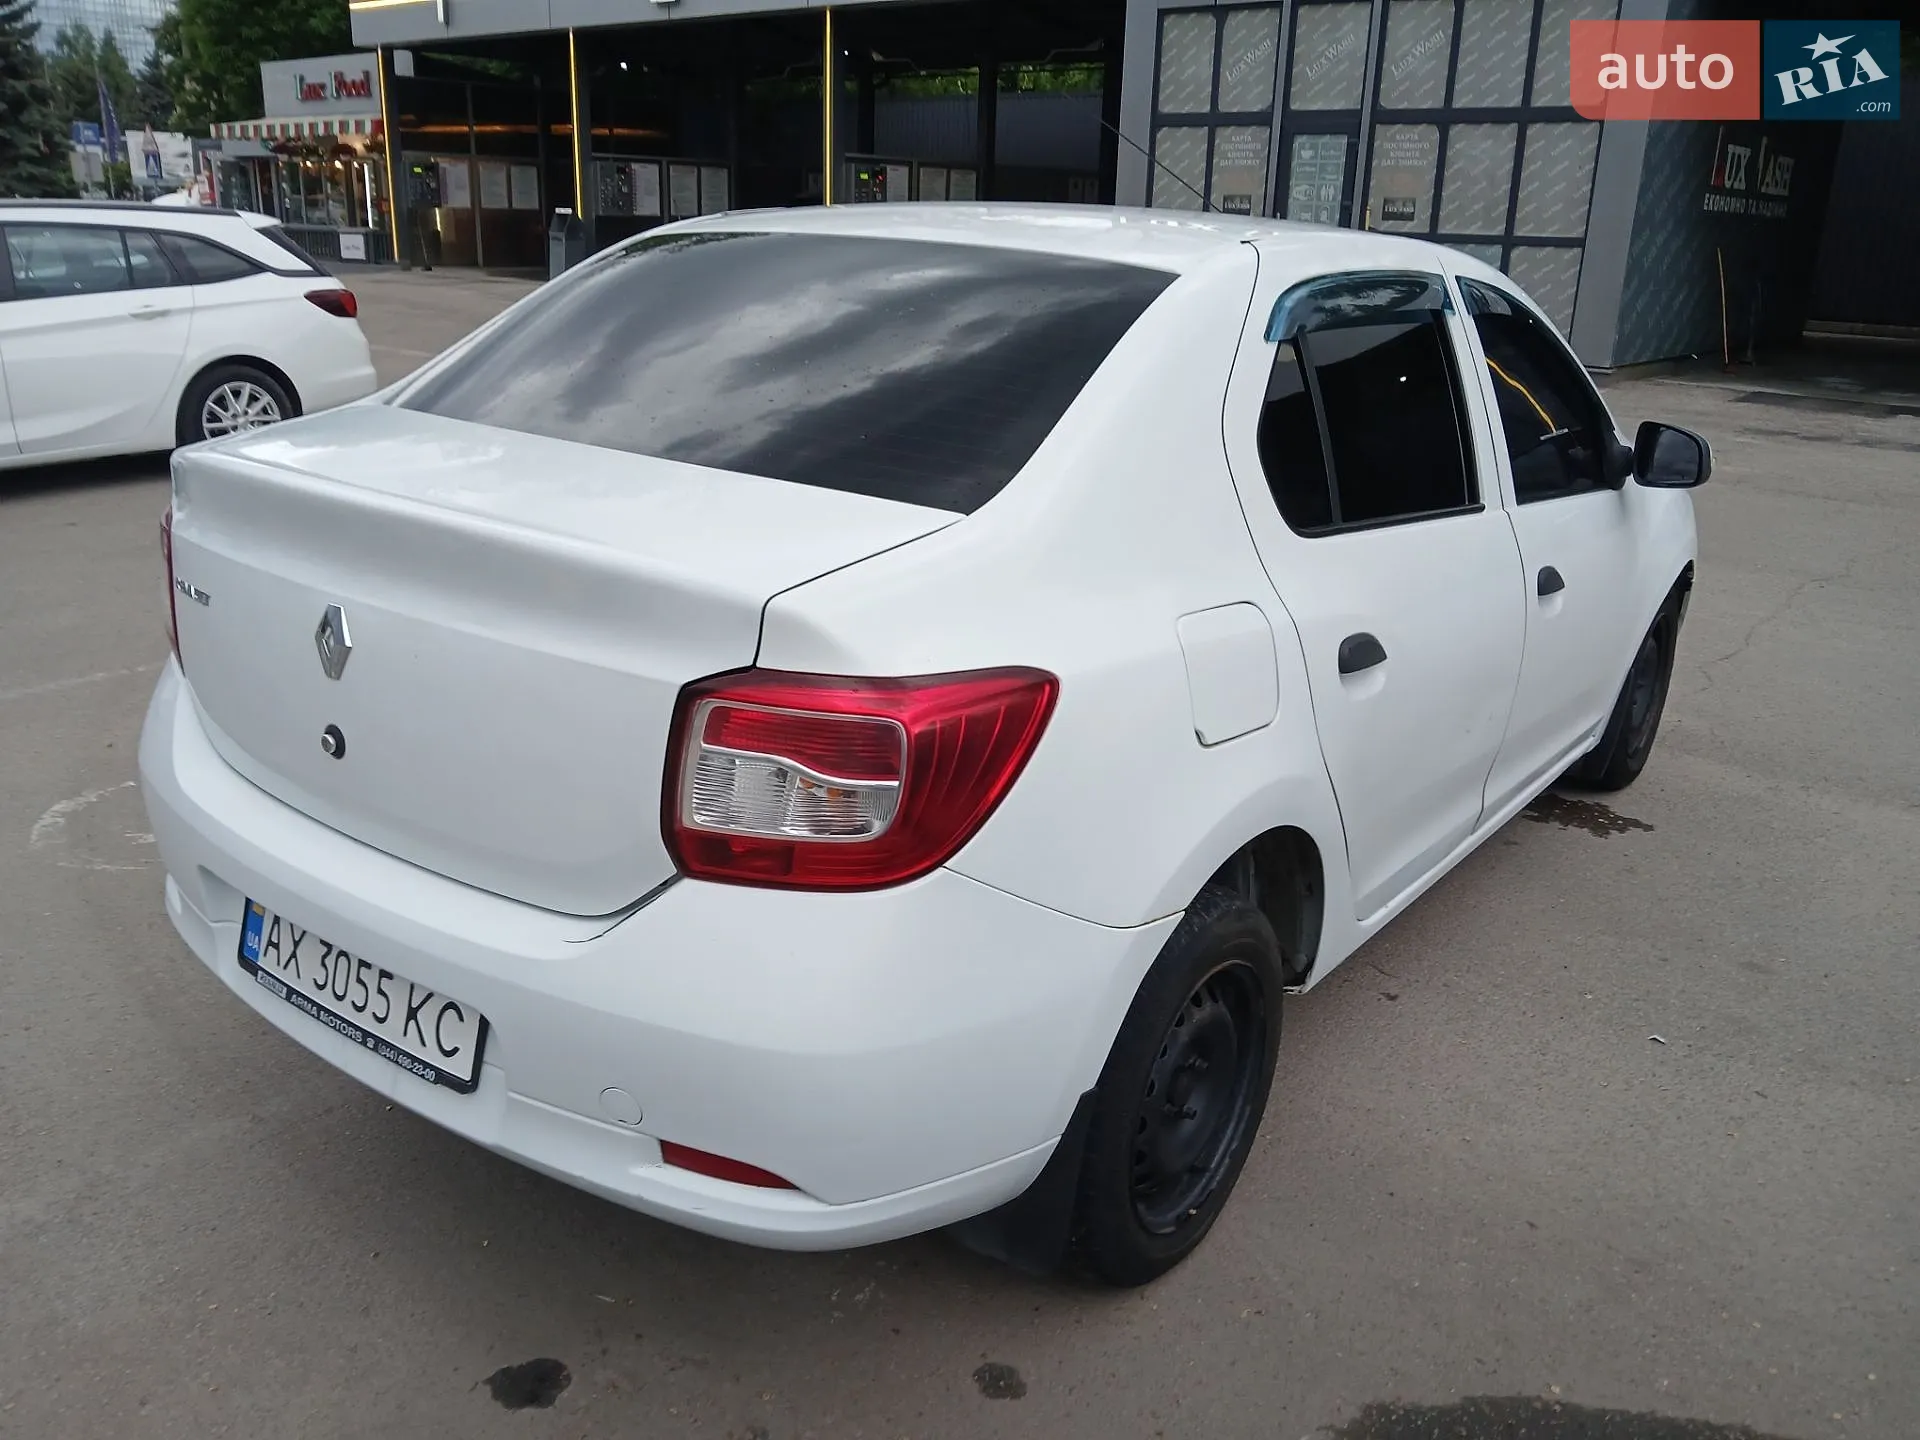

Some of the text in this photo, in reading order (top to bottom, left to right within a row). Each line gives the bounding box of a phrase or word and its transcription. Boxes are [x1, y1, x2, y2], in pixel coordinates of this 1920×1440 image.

[246, 931, 260, 952] UA
[263, 914, 465, 1058] AX 3055 KC
[319, 1010, 363, 1042] MOTORS
